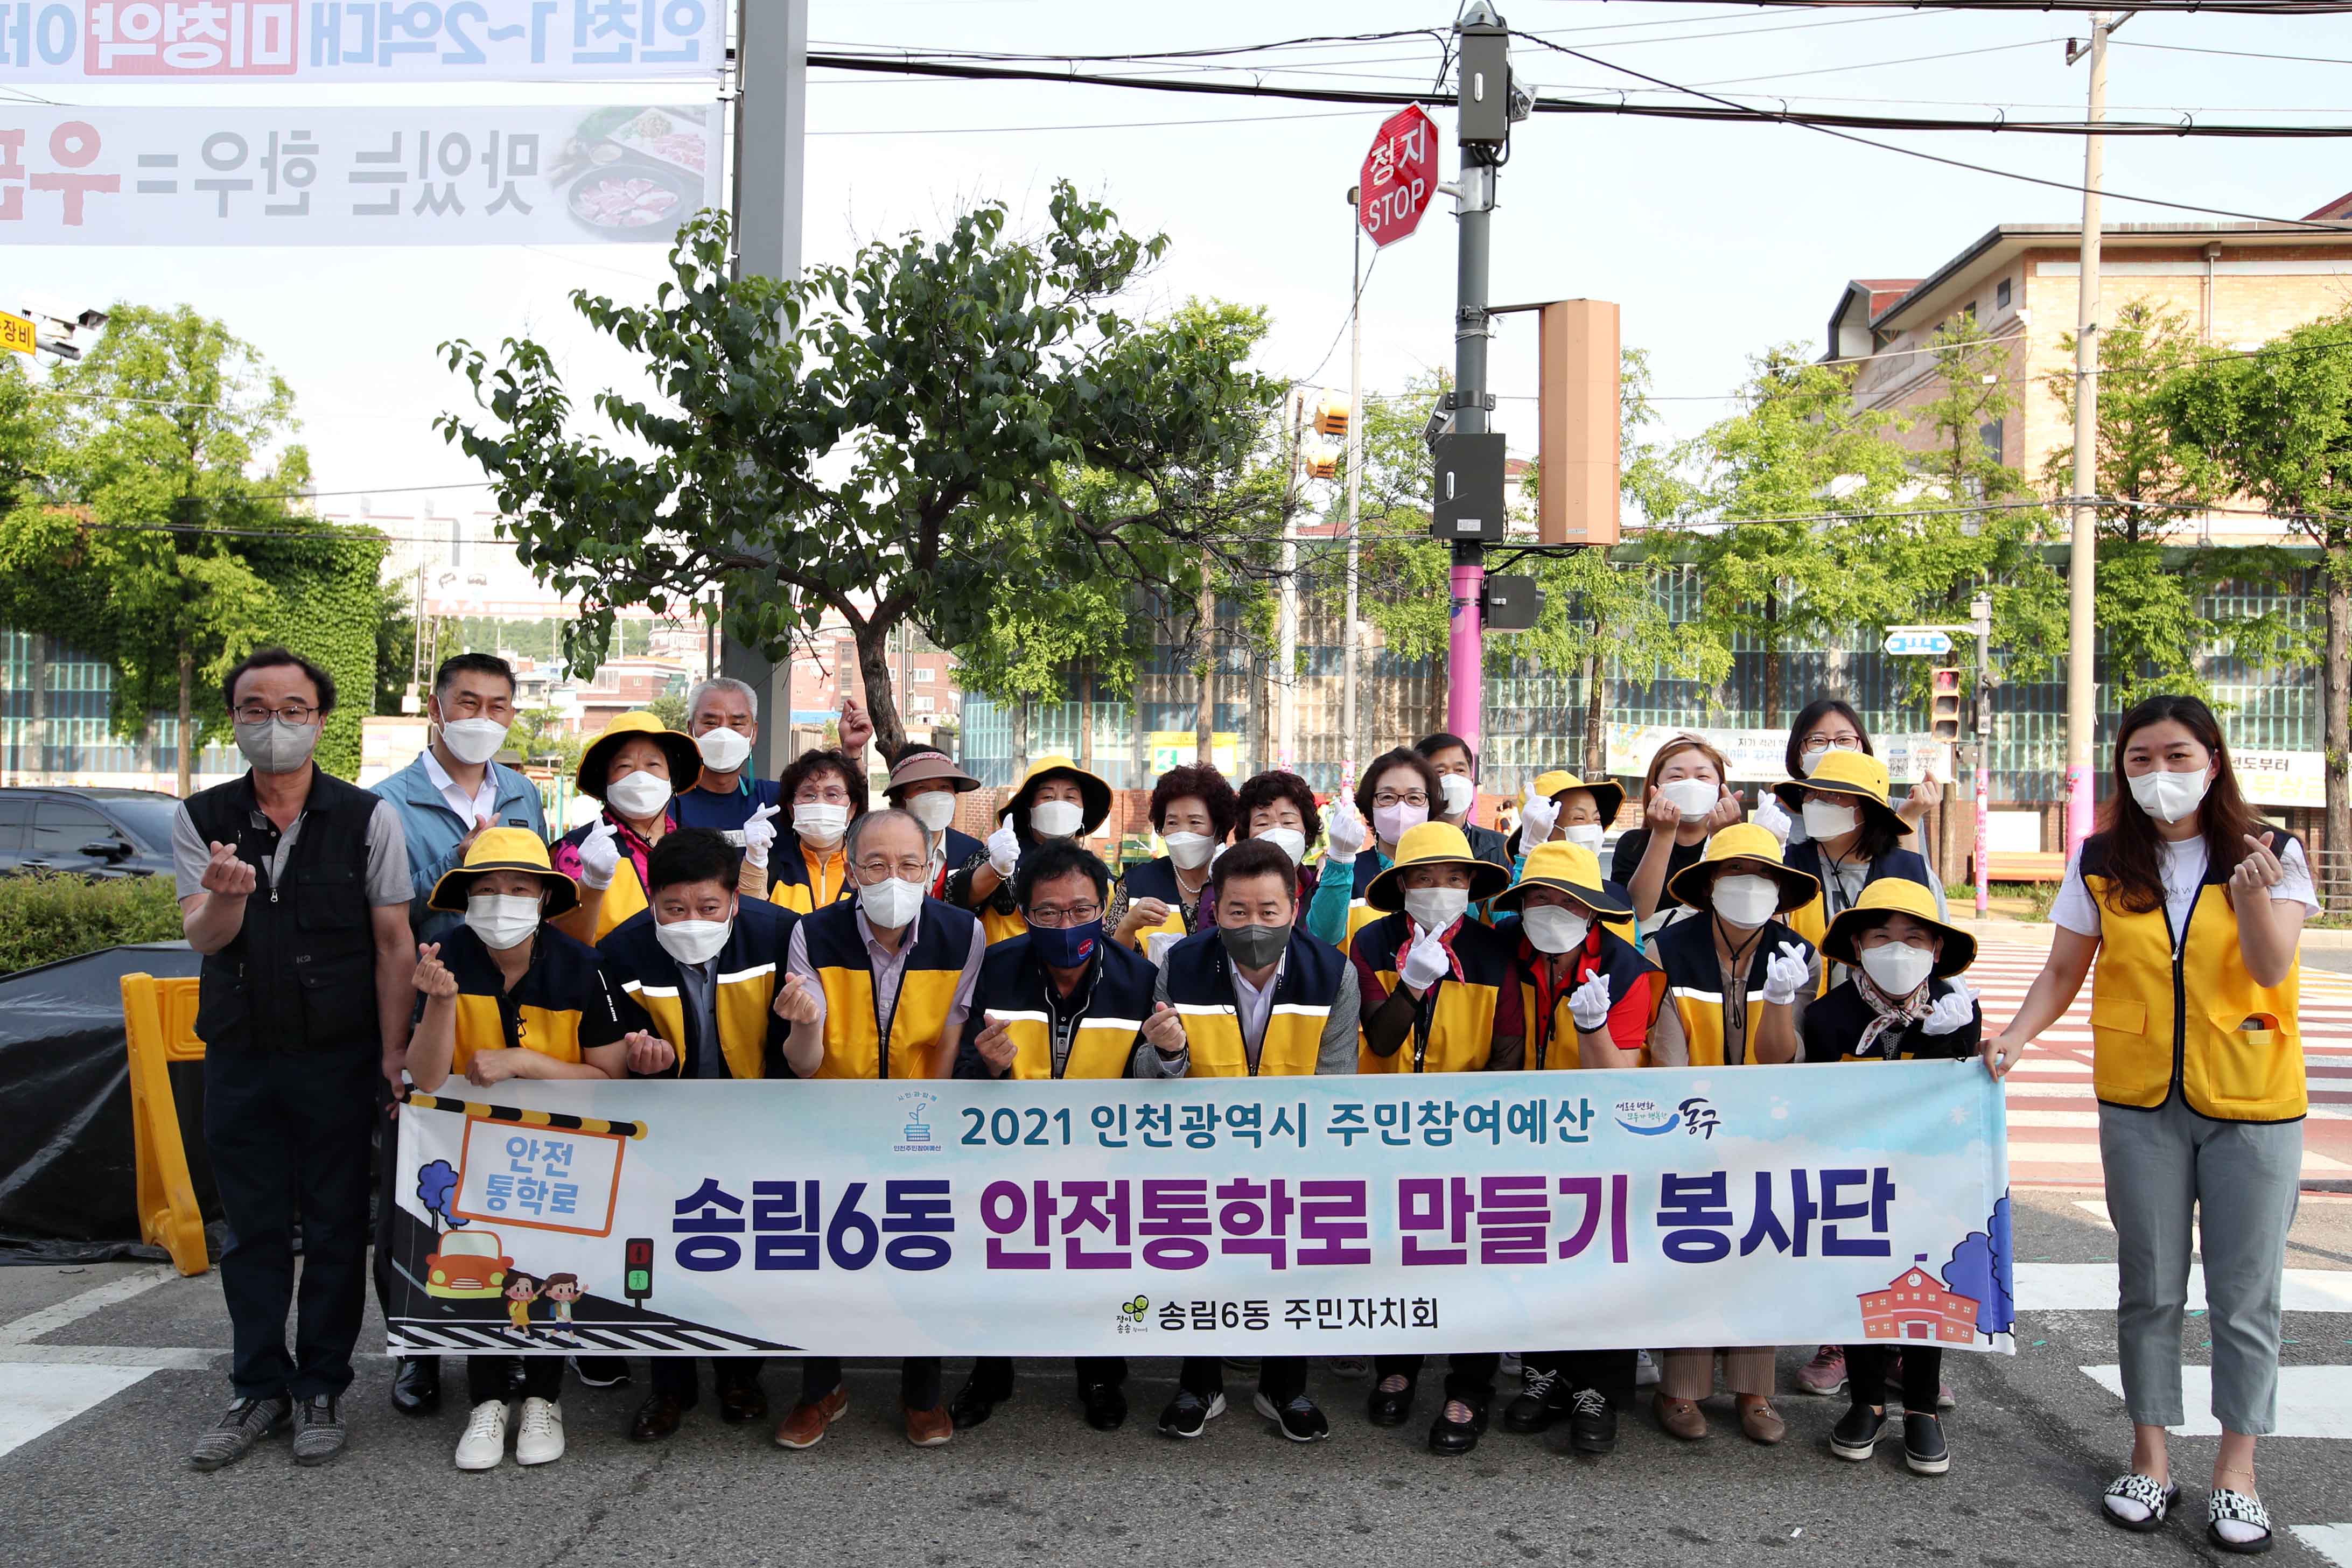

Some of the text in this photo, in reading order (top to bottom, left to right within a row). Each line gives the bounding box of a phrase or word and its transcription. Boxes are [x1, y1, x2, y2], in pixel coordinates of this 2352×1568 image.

[1371, 120, 1425, 186] 정지
[1368, 177, 1425, 233] STOP
[0, 319, 30, 348] 장비
[962, 1098, 1595, 1149] 2021 인천광역시 주민참여예산
[1678, 1097, 1721, 1140] 동구
[506, 1137, 573, 1178] 안전
[486, 1174, 578, 1215] 통학로
[673, 1167, 1895, 1272] 송림6동 안전통학로 만들기 봉사단
[1158, 1297, 1438, 1331] 송림6동 주민자치회
